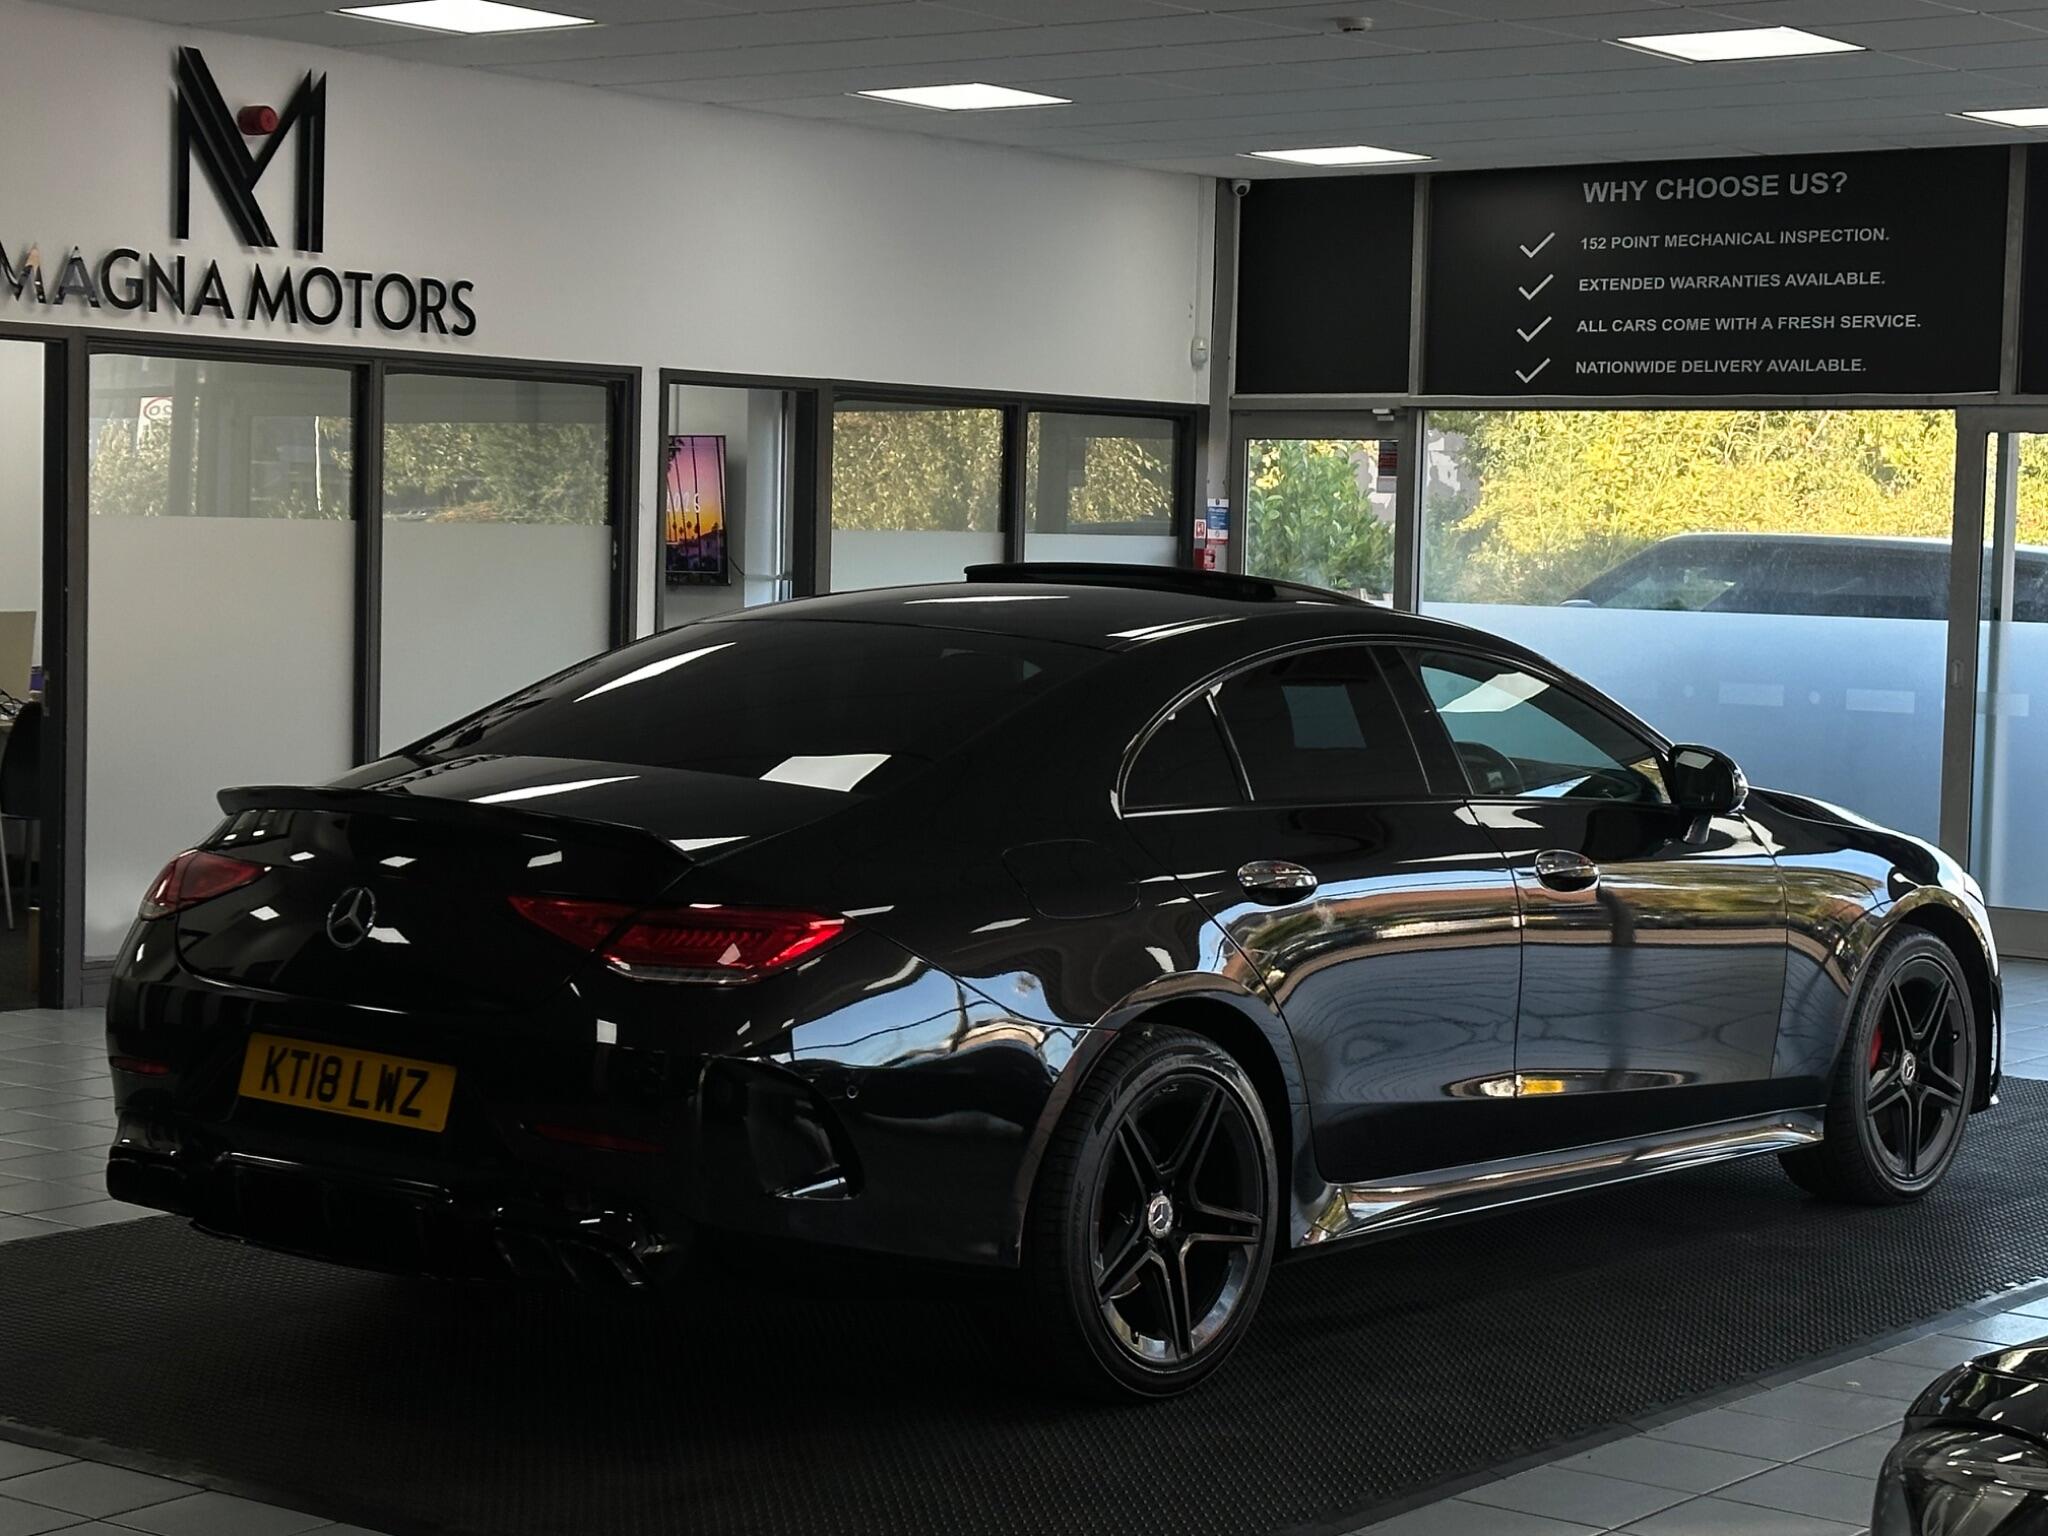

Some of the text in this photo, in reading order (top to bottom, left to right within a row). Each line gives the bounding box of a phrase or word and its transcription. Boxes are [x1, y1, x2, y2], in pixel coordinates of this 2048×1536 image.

[1582, 171, 1848, 203] WHY CHOOSE US?
[1580, 227, 1890, 250] 152 POINT MECHANICAL INSPECTION.
[0, 241, 477, 337] MAGNA MOTORS
[1578, 271, 1886, 291] EXTENDED WARRANTIES AVAILABLE.
[1576, 314, 1921, 333] ALL CARS COME WITH A FRESH SERVICE.
[1575, 358, 1867, 374] NATIONWIDE DELIVERY AVAILABLE.
[260, 1045, 430, 1119] KT18 LWZ
